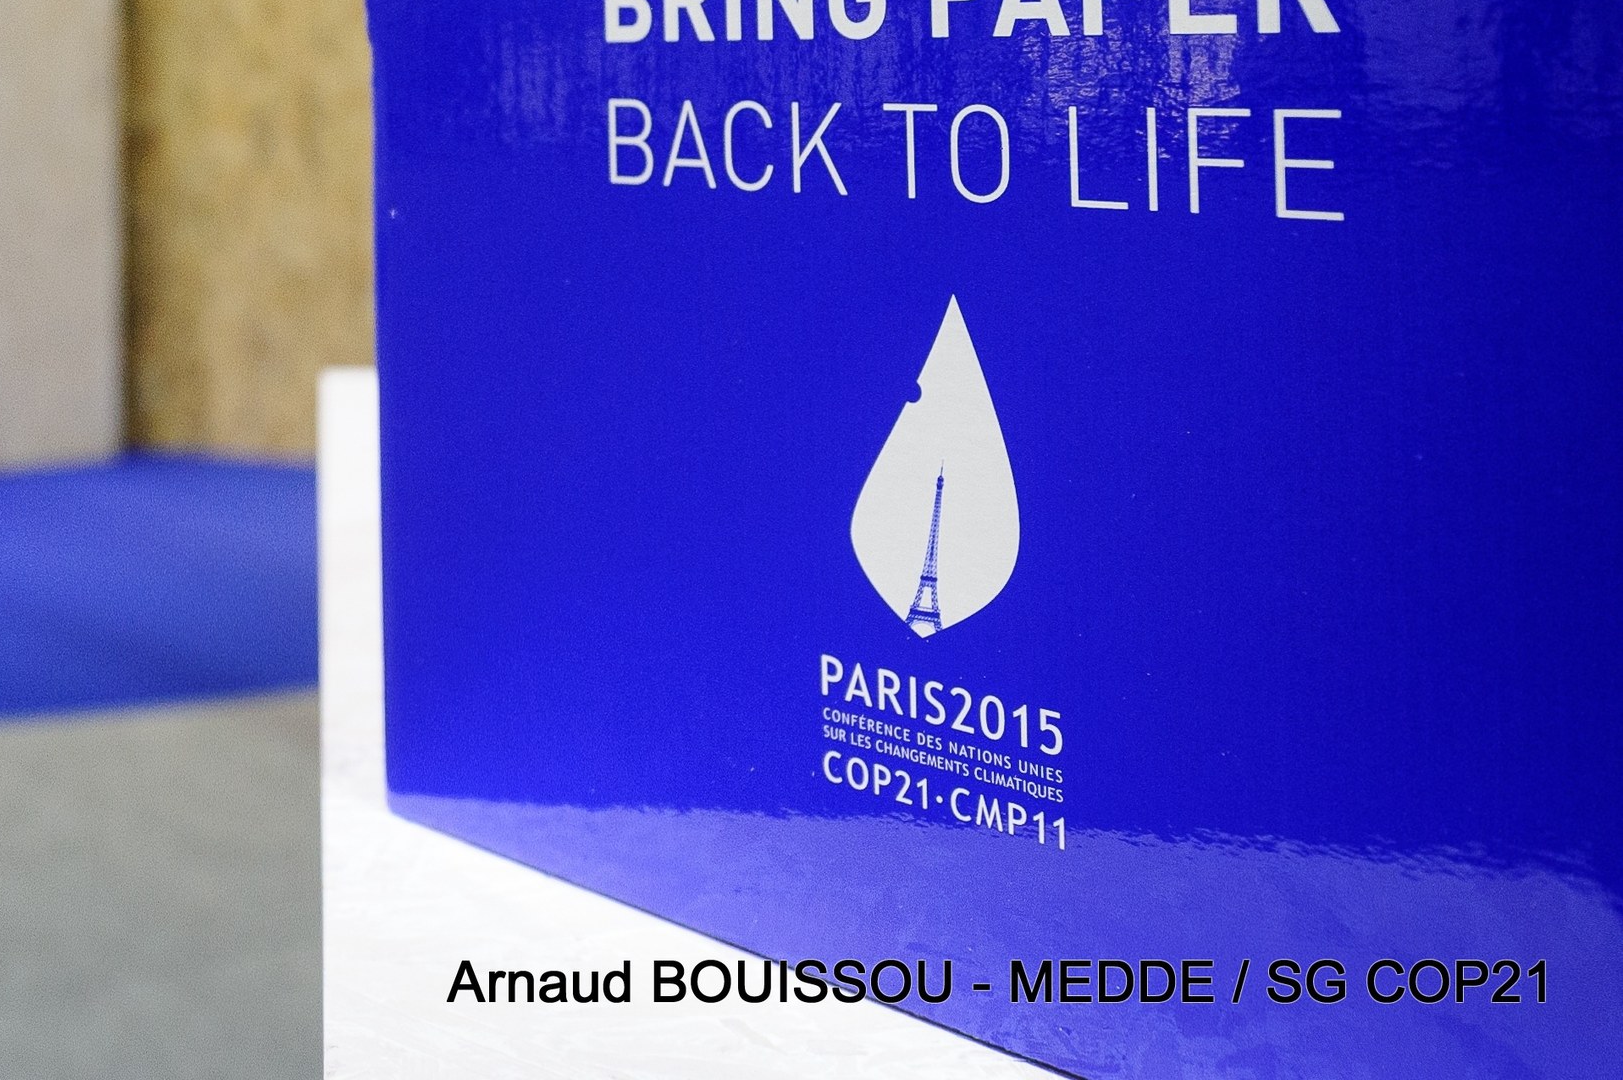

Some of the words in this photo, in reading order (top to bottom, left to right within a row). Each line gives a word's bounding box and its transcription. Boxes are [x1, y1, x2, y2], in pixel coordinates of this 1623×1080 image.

[607, 98, 848, 196] BACK
[883, 103, 1011, 204] TO
[1069, 106, 1345, 221] LIFE
[820, 654, 1064, 755] PARIS2015
[823, 707, 911, 742] CONFÉRENCE
[917, 731, 943, 751] DES
[949, 741, 1012, 769] NATIONS
[1018, 760, 1064, 783] UNIES
[823, 725, 847, 743] SUR
[851, 732, 871, 749] LES
[875, 740, 969, 777] CHANGEMENTS
[974, 768, 1064, 803] CLIMATIQUES
